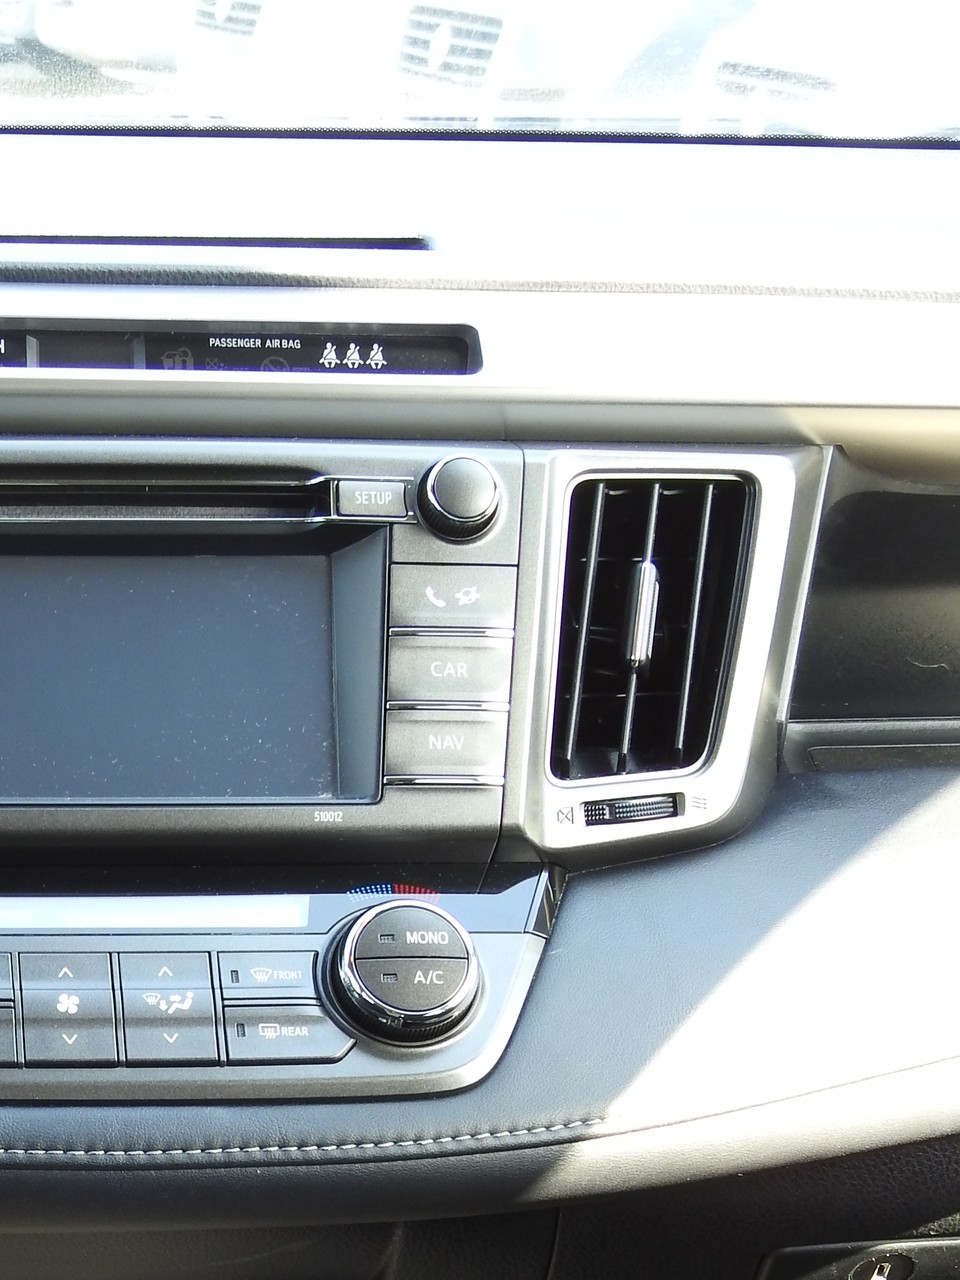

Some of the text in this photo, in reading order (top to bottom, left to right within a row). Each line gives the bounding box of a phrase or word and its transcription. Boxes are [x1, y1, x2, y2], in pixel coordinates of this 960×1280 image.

[209, 337, 261, 348] PASSENGER
[354, 491, 392, 505] SETUP
[430, 662, 468, 677] CAR
[428, 735, 465, 750] NAV
[314, 811, 343, 822] 510012
[405, 931, 449, 944] MONO
[273, 969, 303, 981] FRONT
[413, 970, 444, 985] A/C
[281, 1026, 309, 1037] REAR
